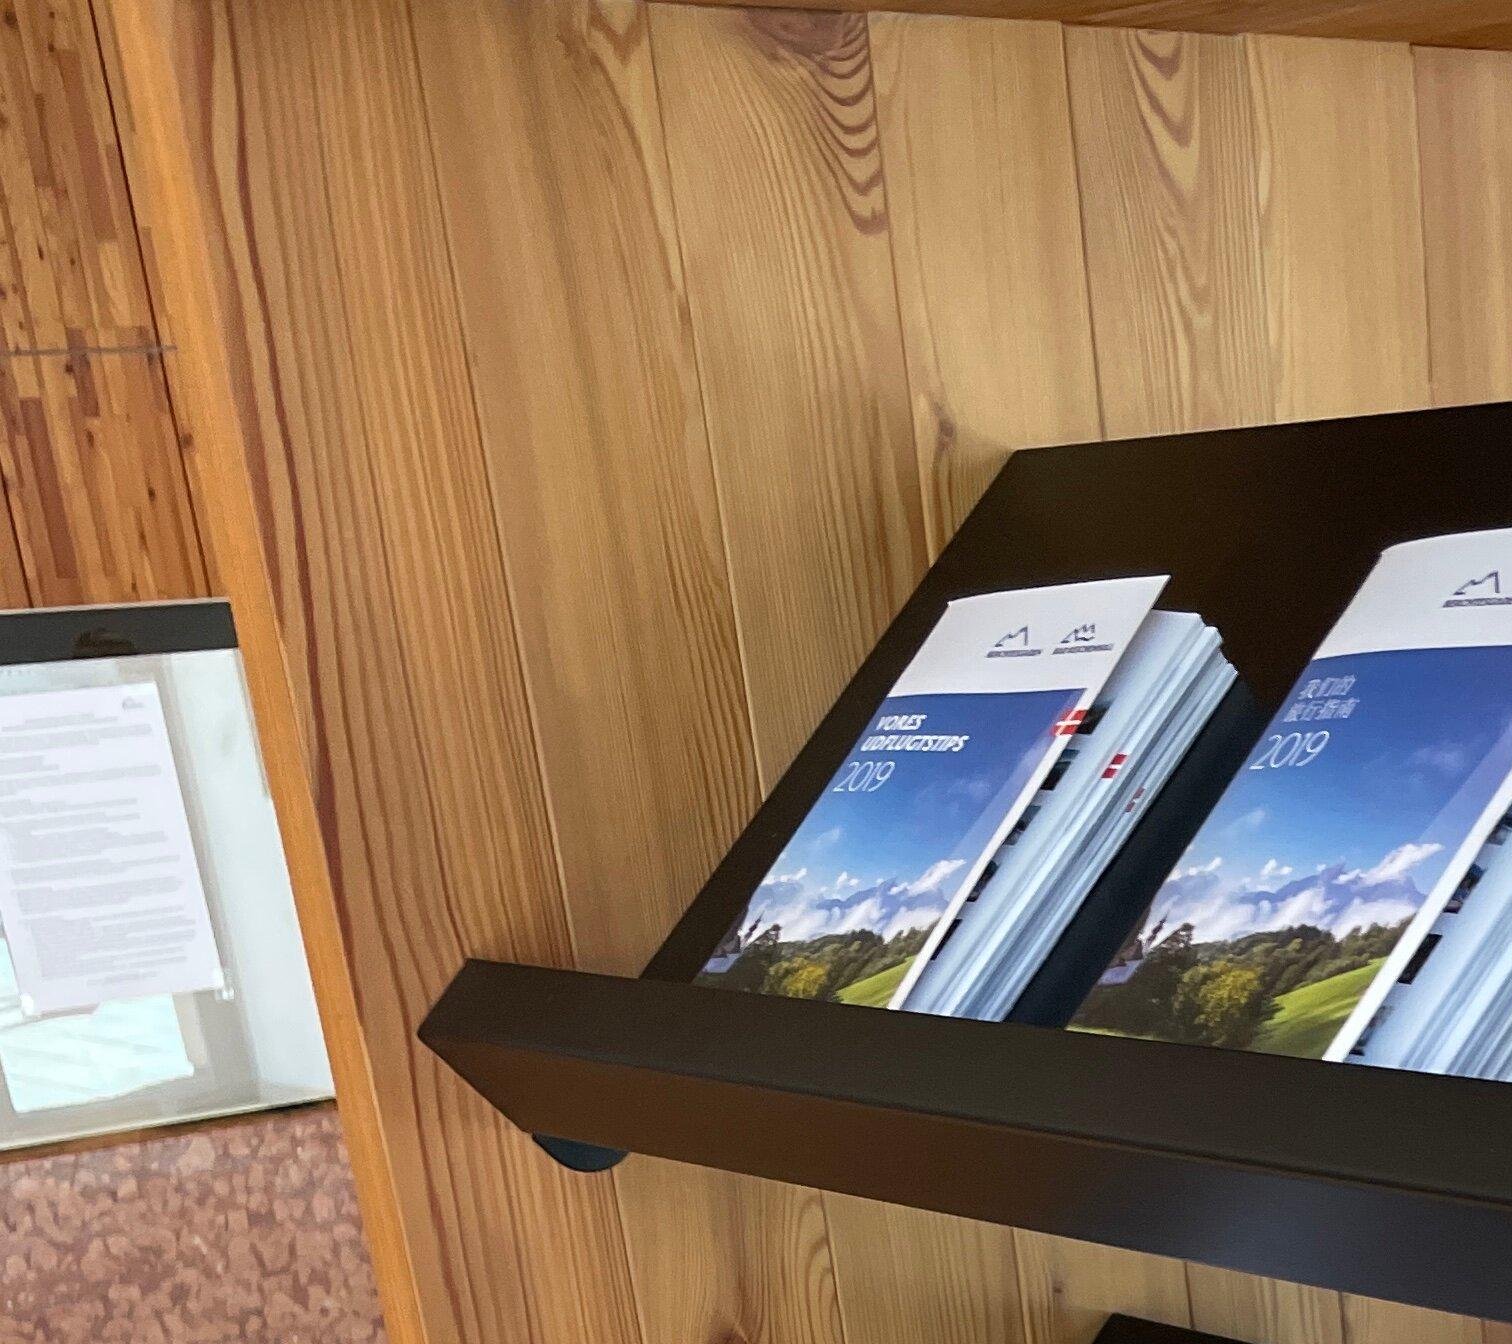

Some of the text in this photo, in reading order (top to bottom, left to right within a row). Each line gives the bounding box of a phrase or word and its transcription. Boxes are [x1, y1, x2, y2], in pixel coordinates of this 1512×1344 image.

[876, 714, 928, 731] VORES
[861, 735, 969, 752] UDFLUGTSTIPS
[1249, 730, 1330, 770] 2019
[833, 761, 895, 792] 2019
